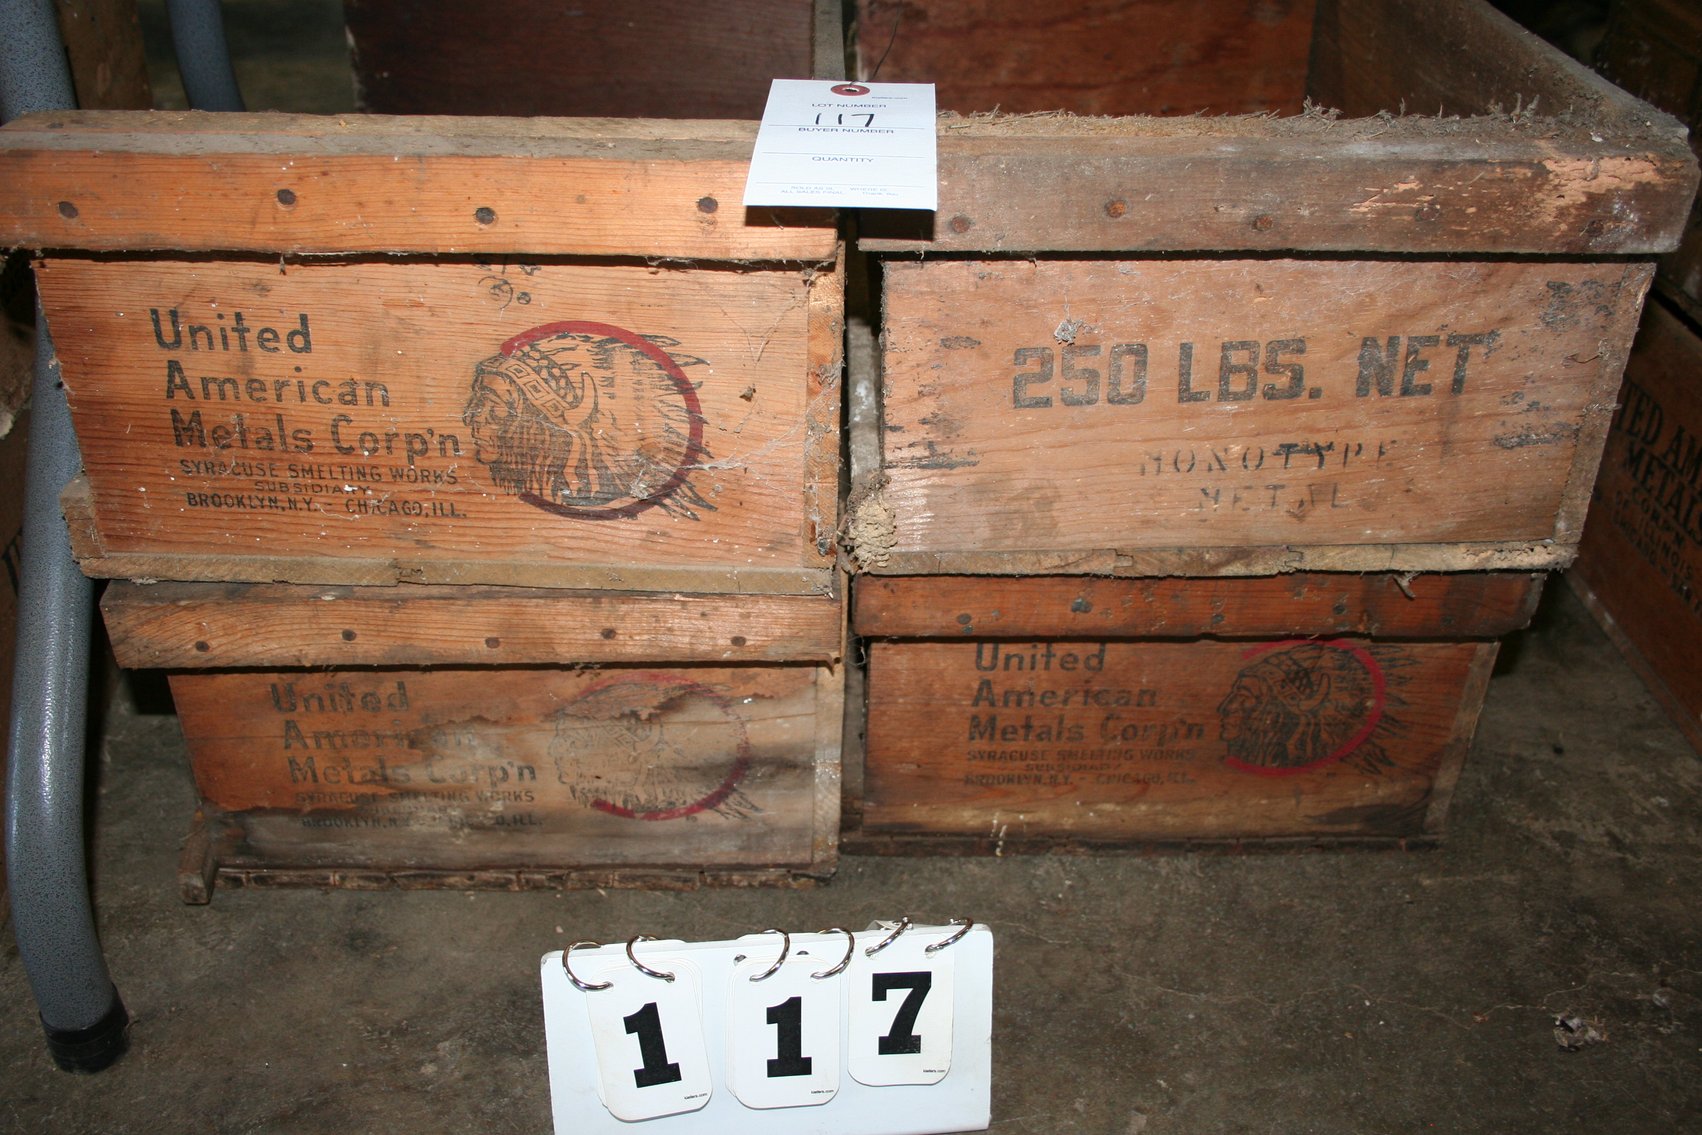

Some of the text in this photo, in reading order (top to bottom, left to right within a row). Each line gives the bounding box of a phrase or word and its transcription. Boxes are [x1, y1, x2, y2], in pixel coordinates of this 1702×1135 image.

[815, 113, 875, 127] 117
[150, 308, 312, 353] United
[166, 360, 390, 407] American
[1013, 331, 1494, 409] 250 LBS. NET
[170, 408, 461, 465] Metals Corp'n
[180, 458, 458, 485] SYRACUSE SMELTING WORKS
[255, 481, 371, 495] SUBSIDIARY
[976, 642, 1106, 672] United
[270, 681, 409, 713] United
[972, 678, 1157, 708] American
[968, 714, 1085, 742] Metals
[288, 756, 411, 785] Metals
[966, 749, 1049, 762] SYRACUSE
[623, 971, 932, 1088] 1 1 7
